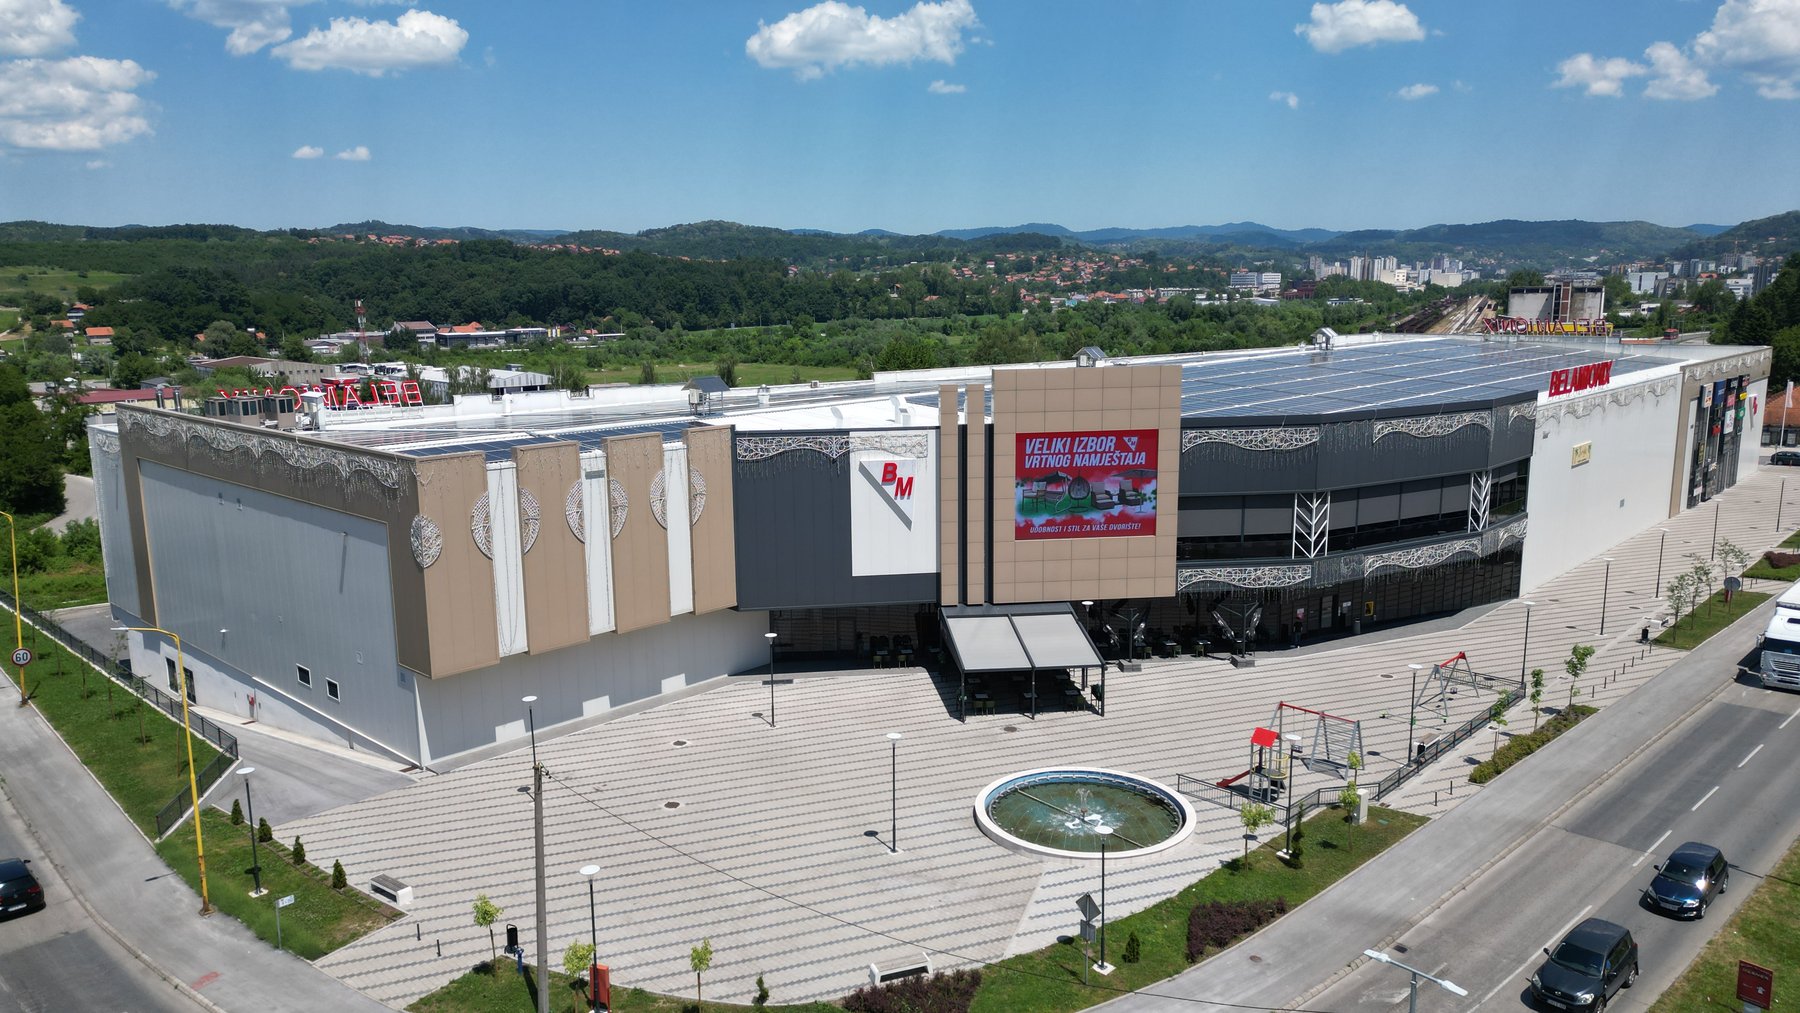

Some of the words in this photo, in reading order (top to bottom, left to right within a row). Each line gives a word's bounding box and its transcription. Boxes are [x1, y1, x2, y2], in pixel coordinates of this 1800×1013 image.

[1025, 437, 1071, 454] VELIKI
[1073, 436, 1117, 453] IZBOR
[1024, 454, 1071, 469] VRTNOG
[1072, 450, 1146, 467] NAMJEŠTAJA
[881, 462, 914, 499] BM
[1030, 525, 1062, 534] UDOBNOST
[1092, 523, 1107, 531] VAŠE
[15, 652, 28, 661] 60
